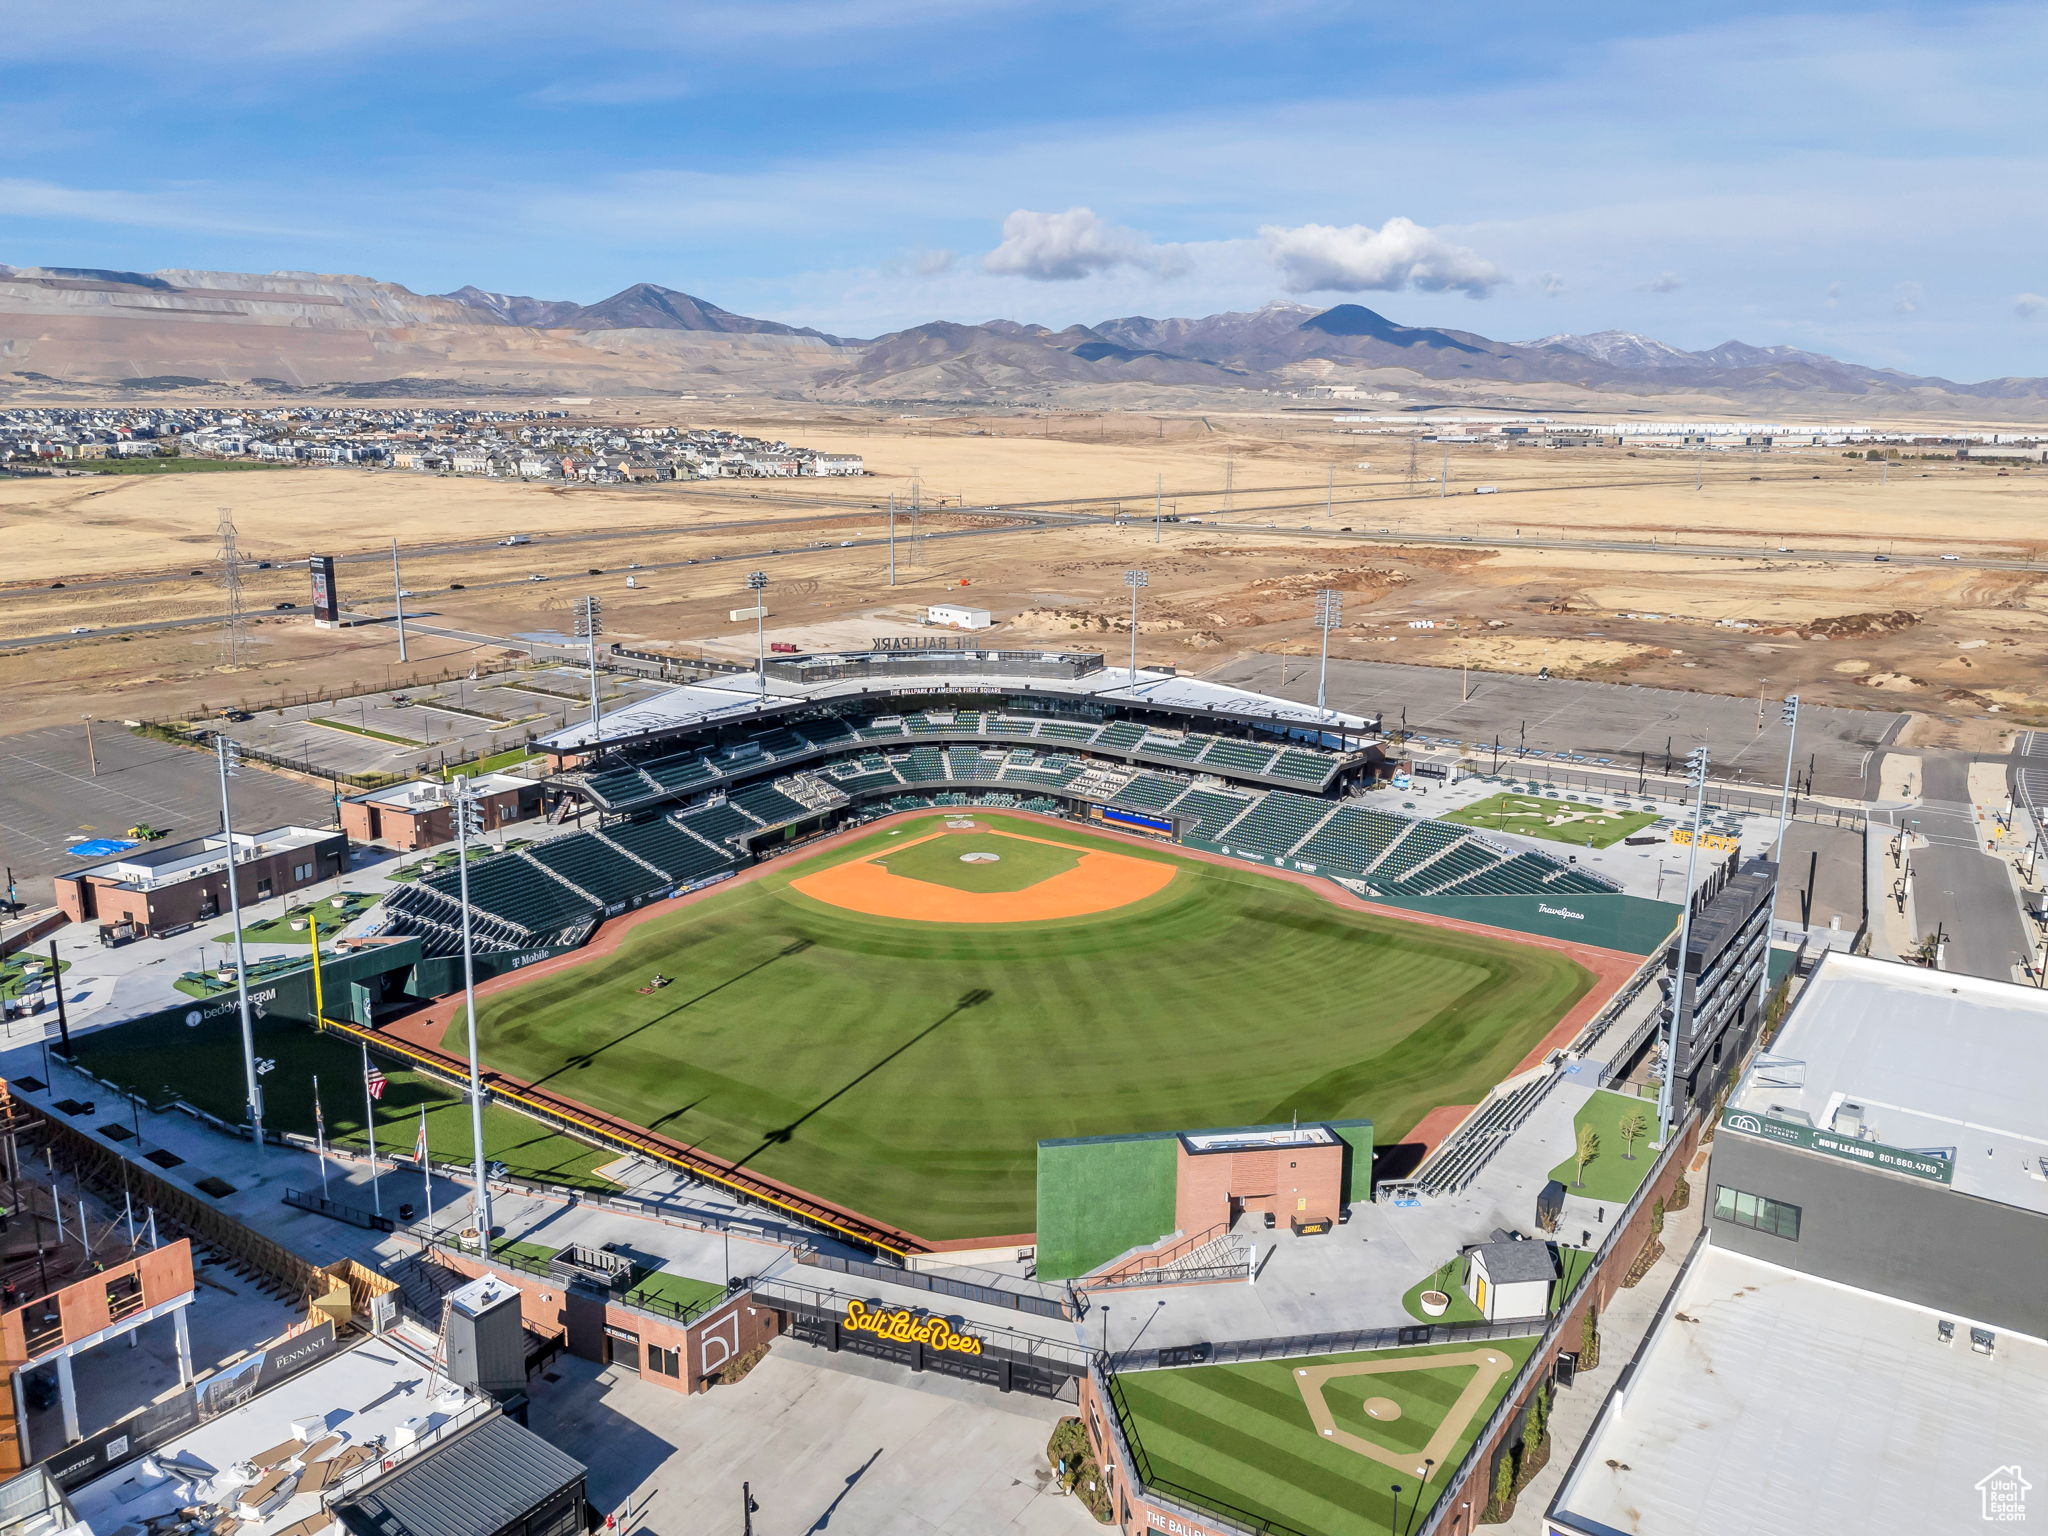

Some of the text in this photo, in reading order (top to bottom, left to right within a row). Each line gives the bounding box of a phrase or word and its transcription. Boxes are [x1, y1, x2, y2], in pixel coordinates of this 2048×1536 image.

[1538, 903, 1585, 920] Travelpass
[521, 949, 550, 966] Mobile
[1765, 1123, 1799, 1136] DOWNTOWN
[1818, 1138, 1937, 1174] NOW LEASING 801.660.4760
[843, 1299, 982, 1356] Salt Lake Bees
[275, 1337, 327, 1369] PENNANT
[1146, 1511, 1167, 1529] THE
